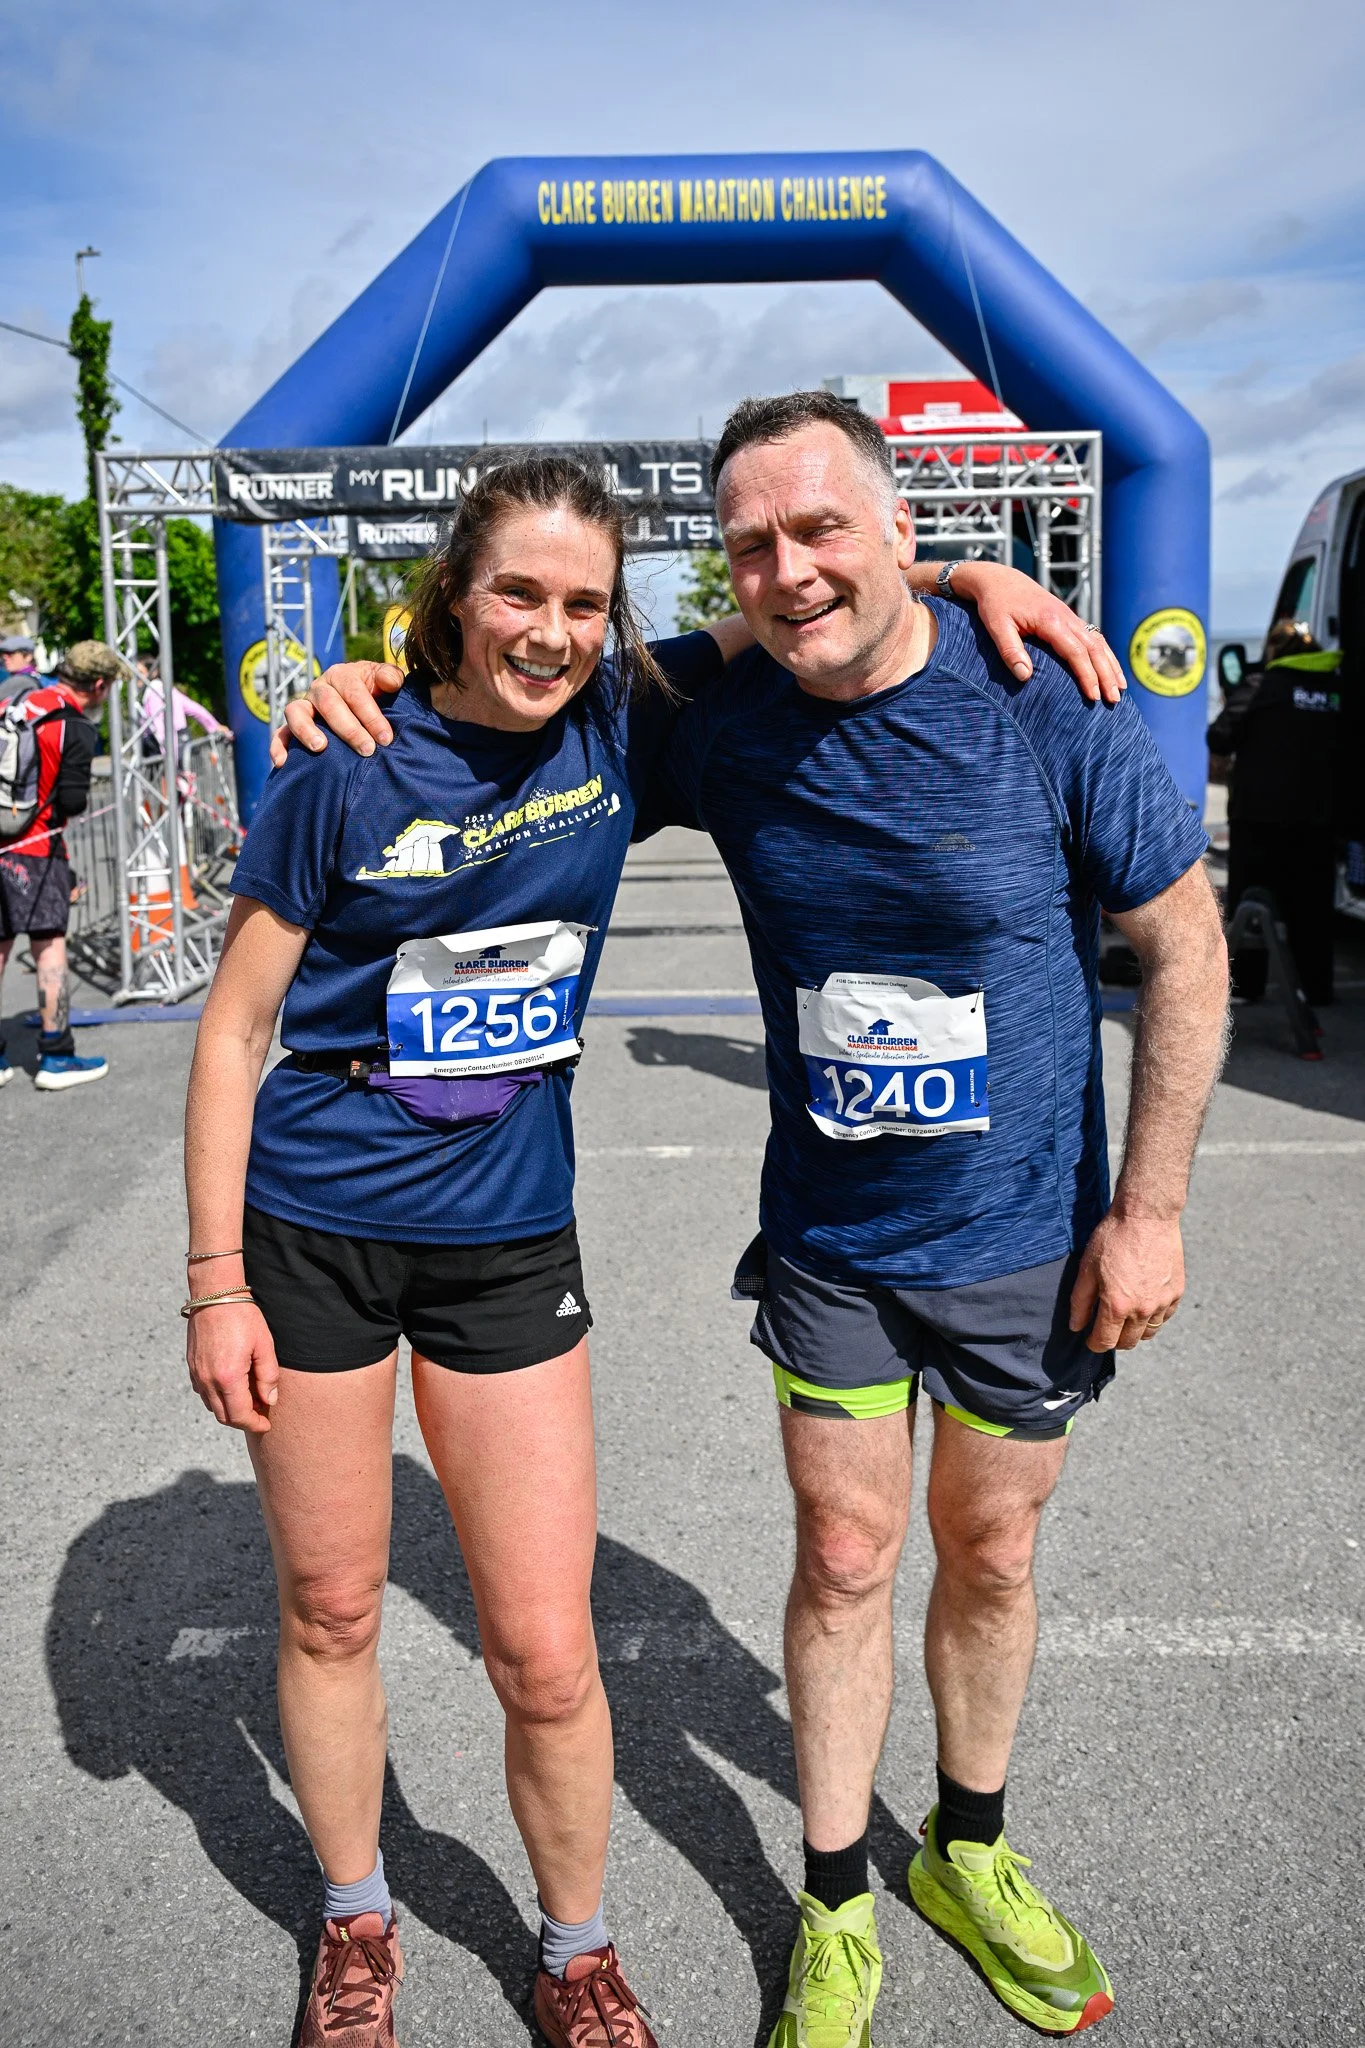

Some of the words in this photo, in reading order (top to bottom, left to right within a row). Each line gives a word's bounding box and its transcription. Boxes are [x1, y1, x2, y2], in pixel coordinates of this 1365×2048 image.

[538, 180, 597, 225] CLARE
[602, 179, 673, 224] BURREN
[679, 178, 775, 223] MARATHON
[781, 175, 887, 222] CHALLENGE
[350, 469, 380, 486] MY
[229, 473, 334, 500] RUNNER
[463, 806, 525, 848] CLARE
[525, 774, 603, 822] BURREN
[464, 813, 494, 824] 2025
[465, 830, 531, 860] MARATHON
[539, 798, 609, 833] CHALLENGE
[454, 961, 486, 969] CLARE
[488, 960, 529, 969] BURREN
[411, 987, 558, 1054] 1256
[847, 1034, 875, 1044] CLARE
[877, 1037, 918, 1046] BURREN
[847, 1042, 882, 1050] MARATHON
[823, 1065, 955, 1122] 1240
[859, 1126, 882, 1136] Contact
[555, 1305, 581, 1317] adidas
